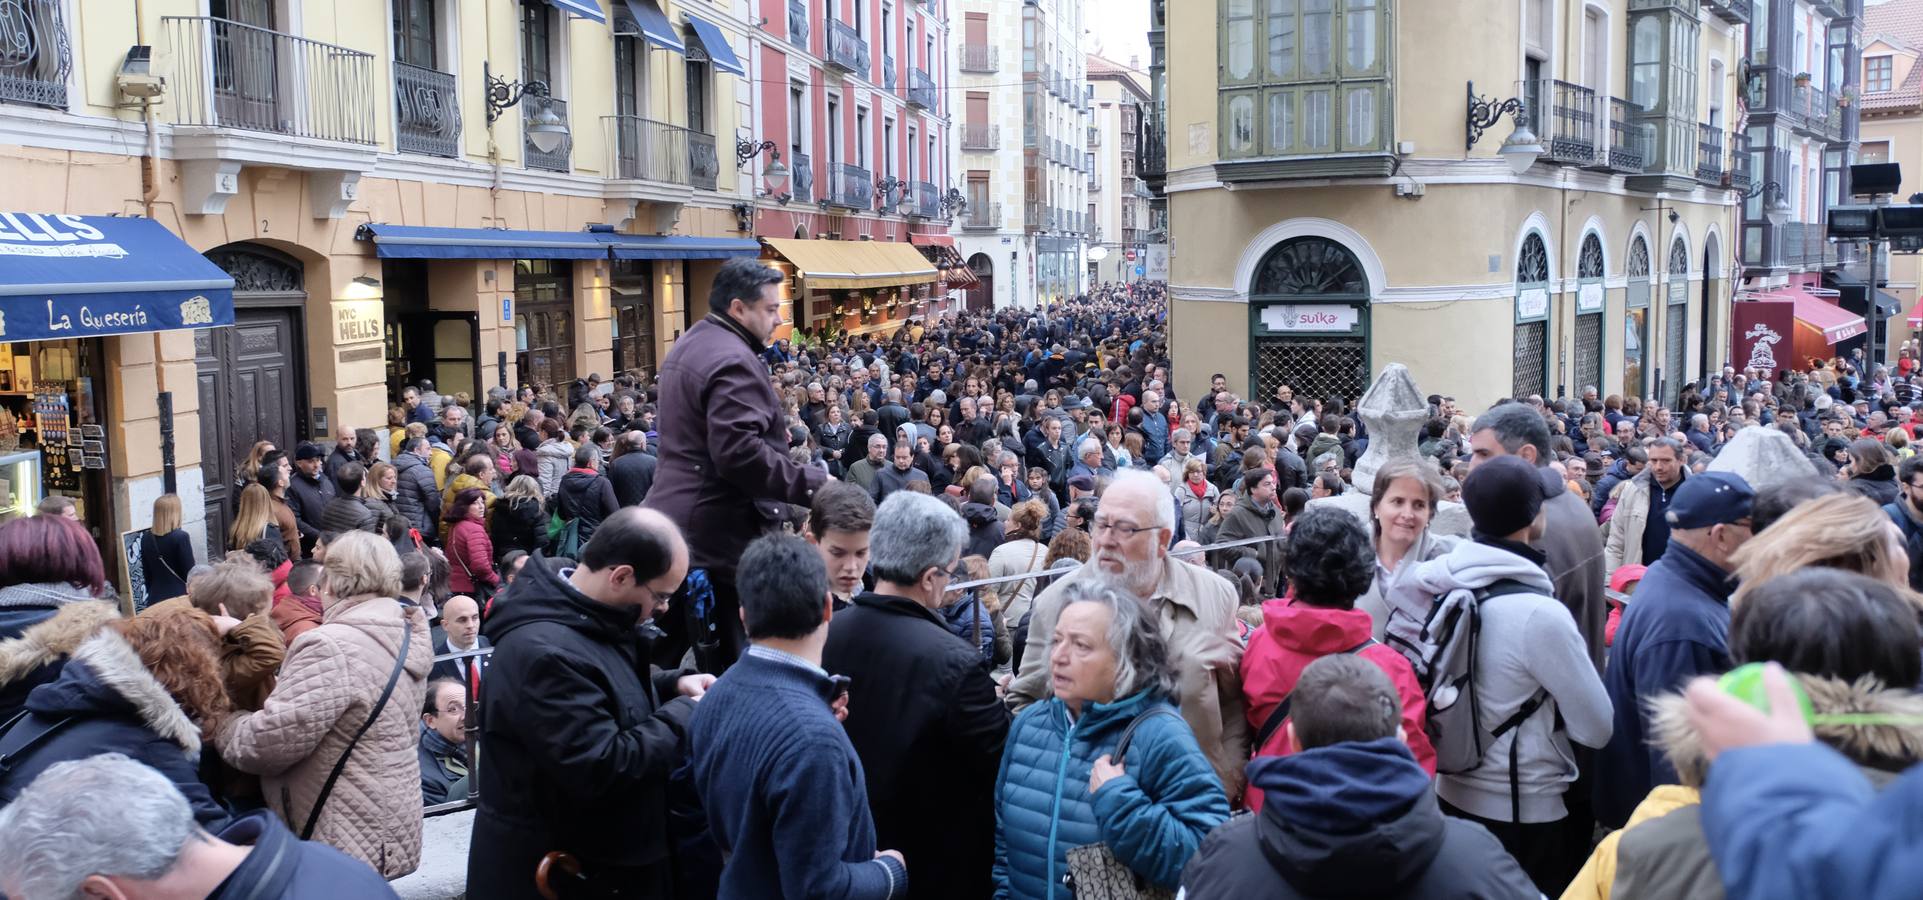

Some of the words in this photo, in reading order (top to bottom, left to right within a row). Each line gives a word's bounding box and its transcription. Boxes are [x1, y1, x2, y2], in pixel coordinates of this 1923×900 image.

[262, 219, 269, 233] 2
[47, 299, 72, 330] La
[80, 304, 147, 330] Quesería
[339, 308, 356, 320] NYC
[1300, 312, 1338, 324] suika
[340, 319, 379, 340] HELL'S
